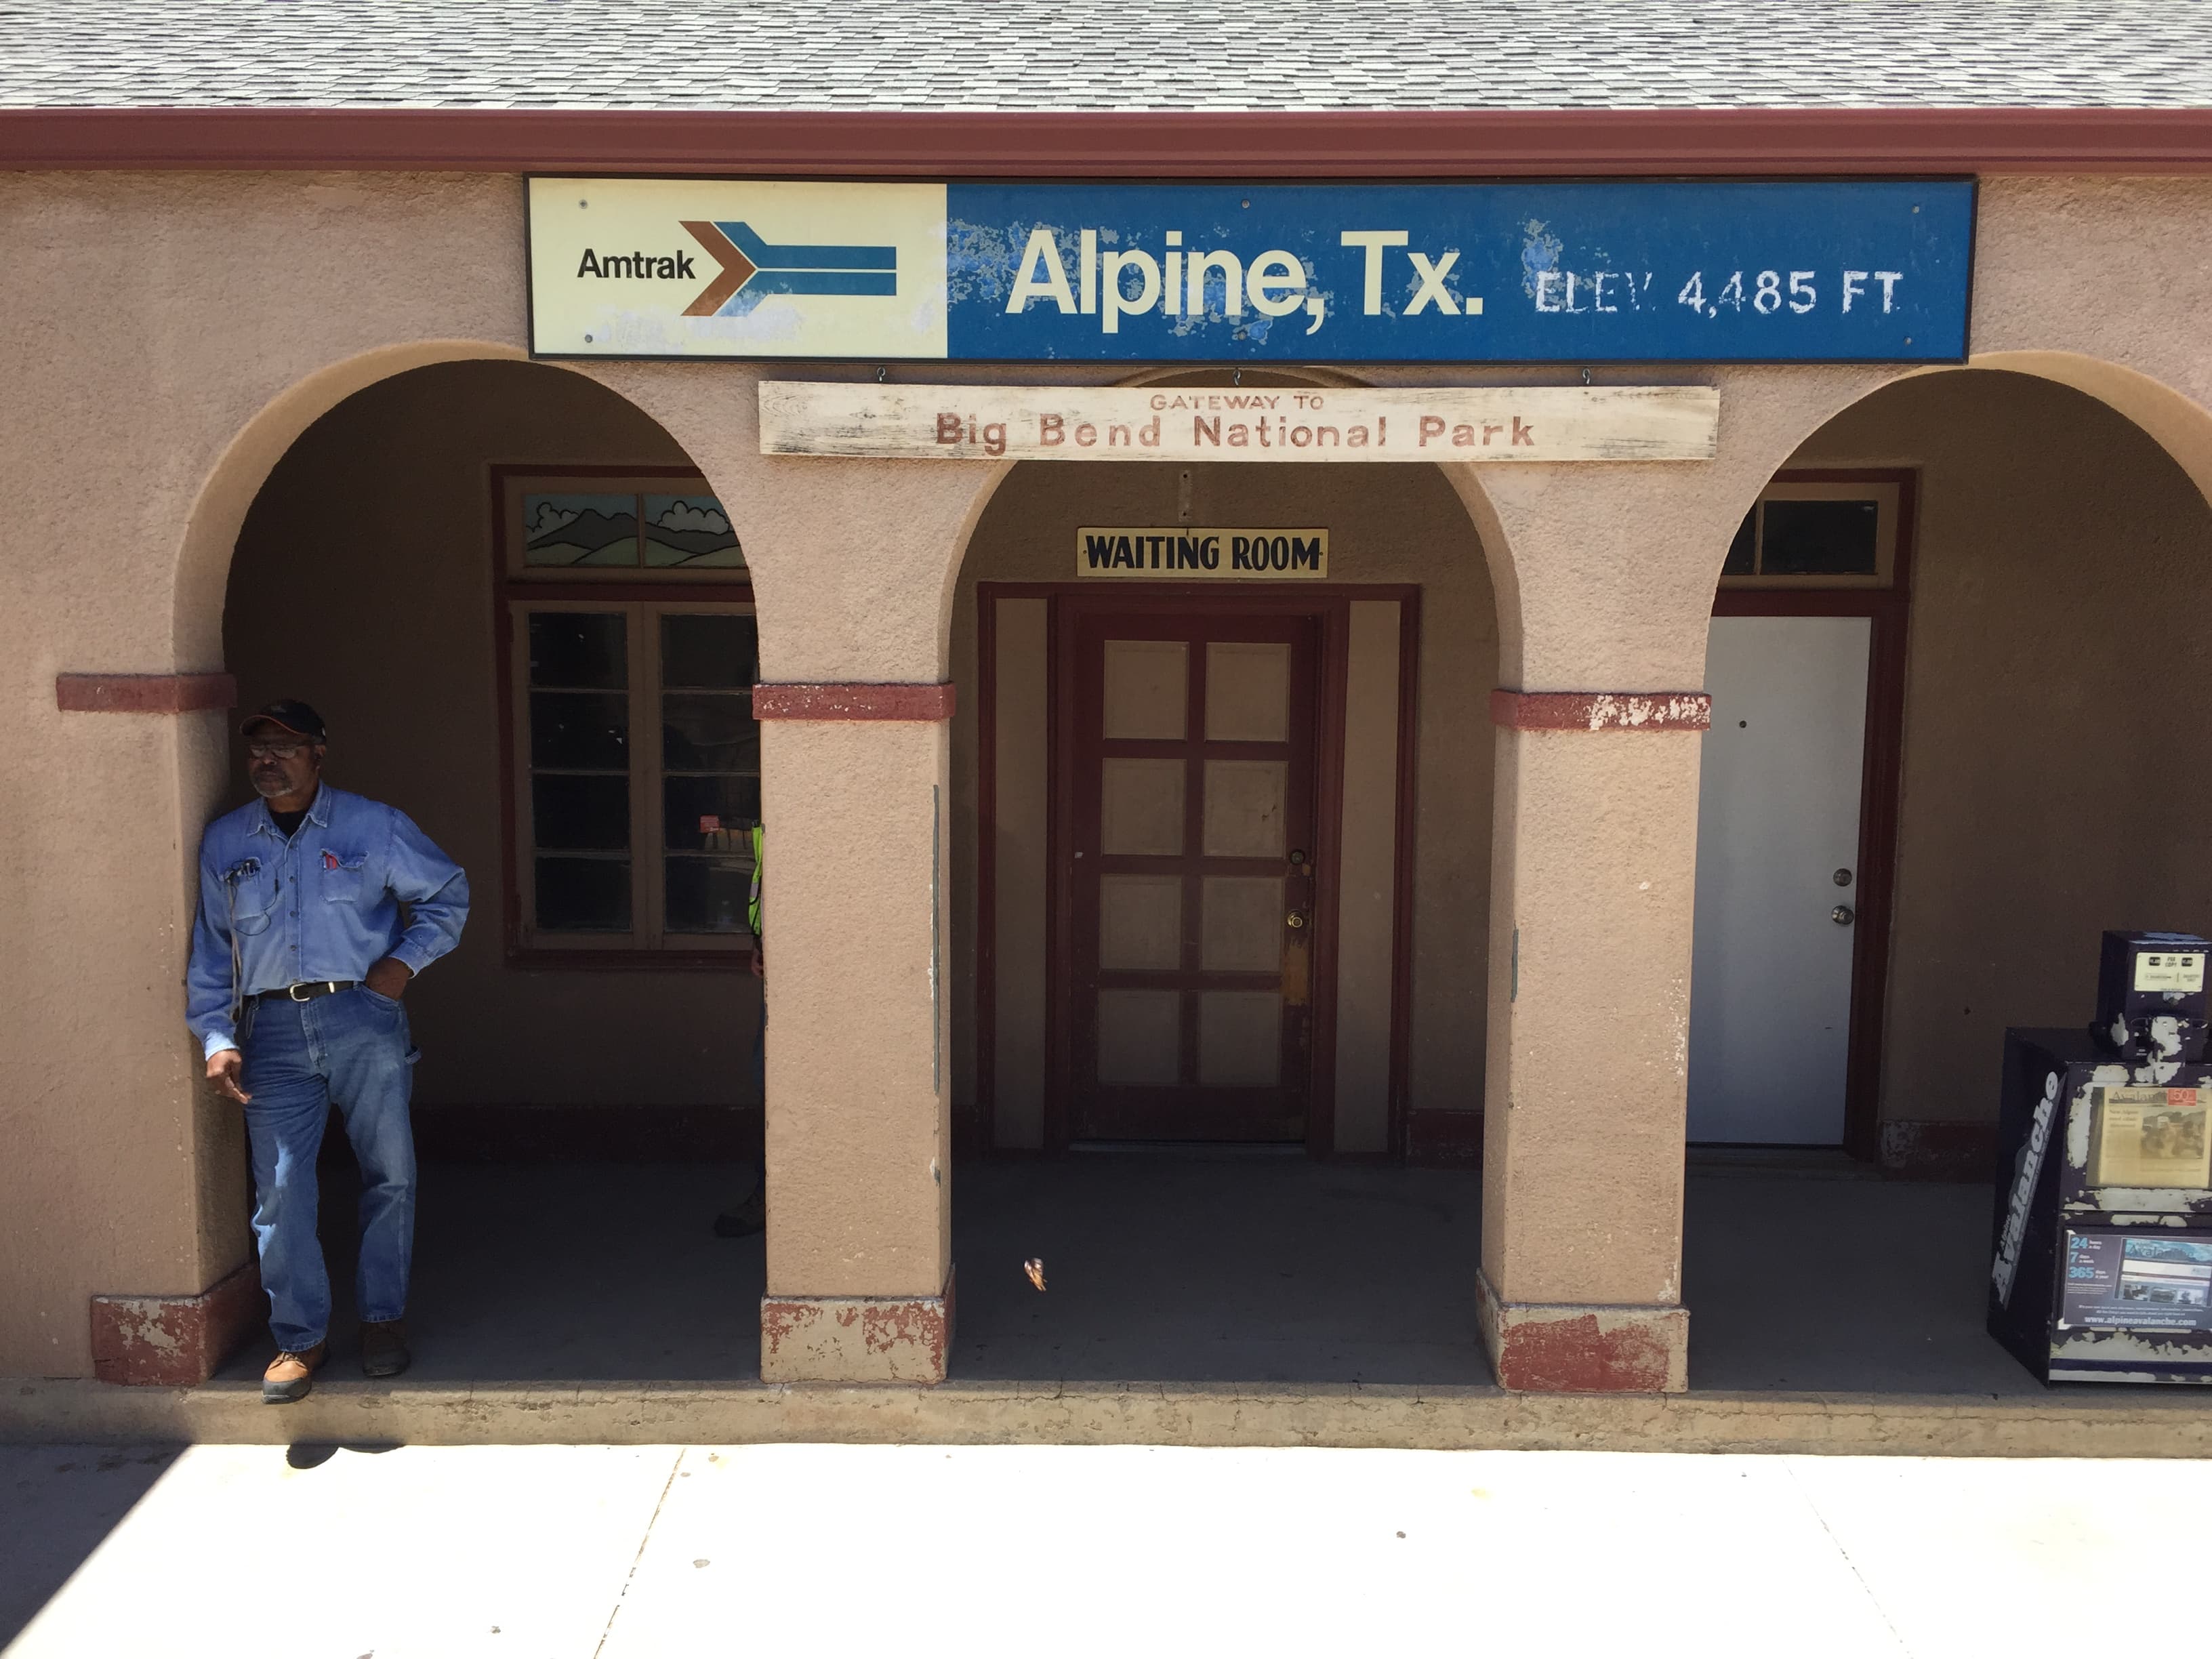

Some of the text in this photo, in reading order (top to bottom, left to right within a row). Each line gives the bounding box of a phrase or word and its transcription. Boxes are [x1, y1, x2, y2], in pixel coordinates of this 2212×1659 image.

[577, 249, 696, 279] Amtrak
[1005, 229, 1483, 335] Alpine, Tx.
[1678, 270, 1816, 319] 4,485
[1842, 270, 1903, 314] FT
[1150, 394, 1324, 410] GATEWAY TO
[936, 412, 1536, 455] Big Bend National Park
[1086, 535, 1320, 571] WAITING ROOM
[1992, 1071, 2058, 1304] Avalanche
[2070, 1237, 2088, 1249] 24
[2070, 1252, 2079, 1263] 7
[2068, 1267, 2094, 1279] 365
[2084, 1315, 2196, 1326] www.alpineavalanche.com
